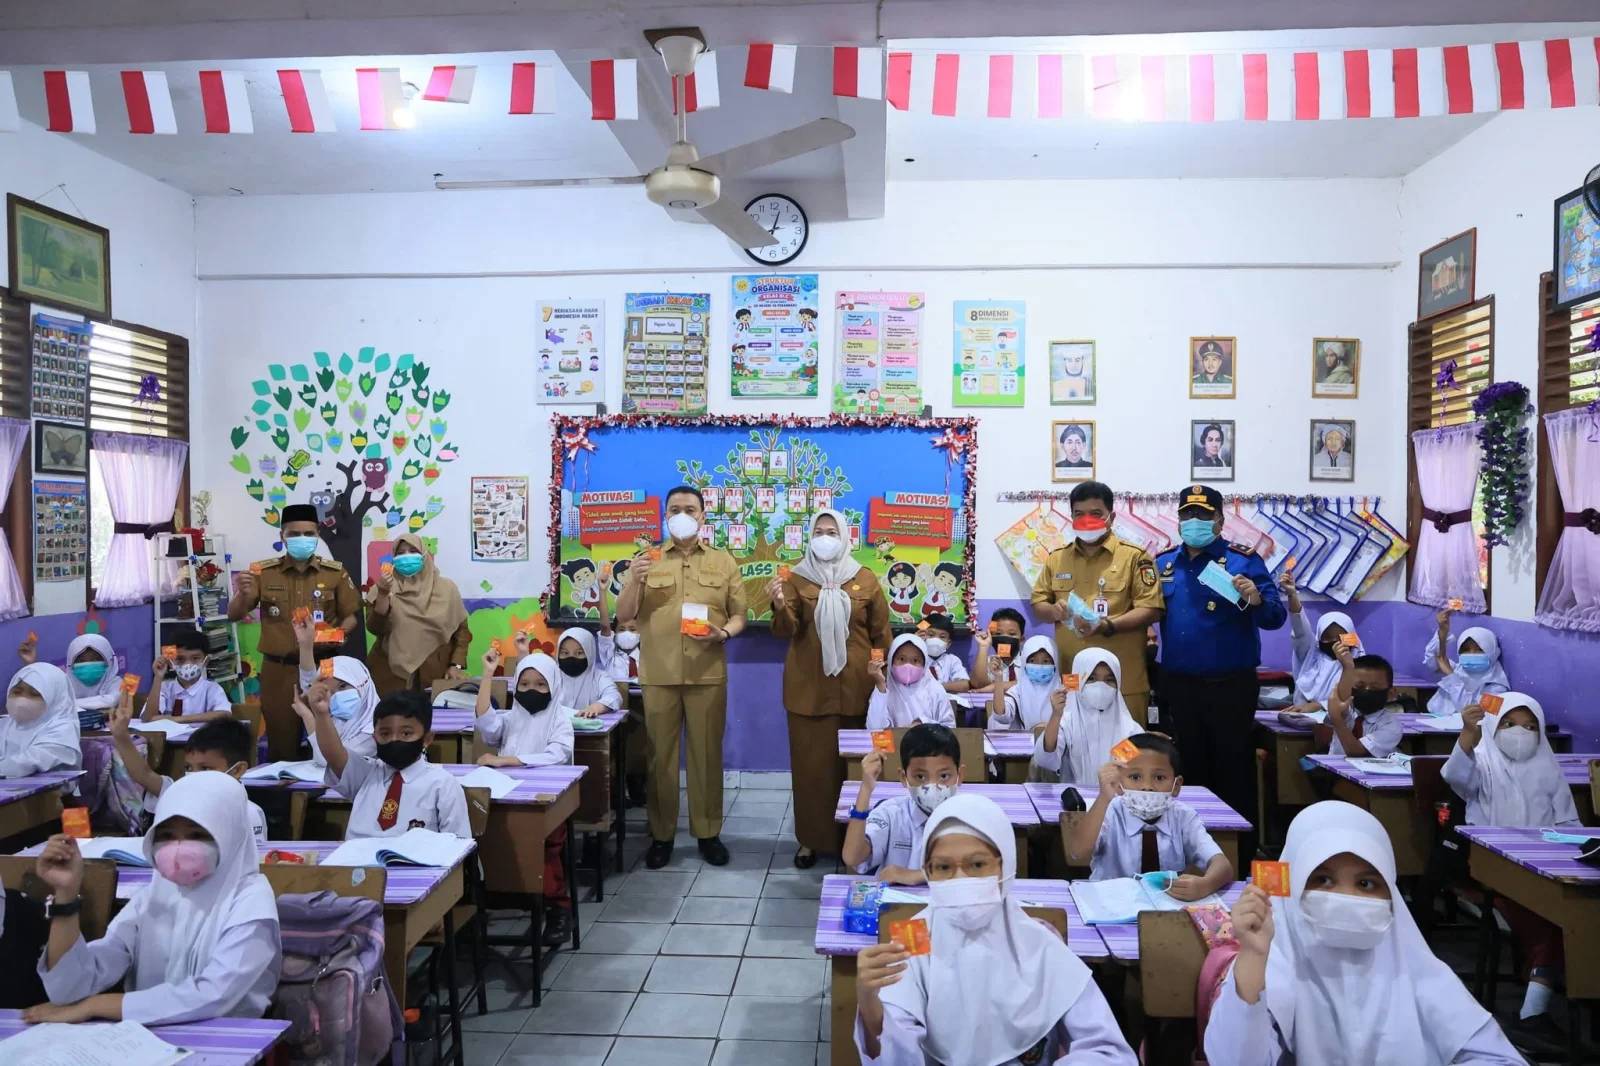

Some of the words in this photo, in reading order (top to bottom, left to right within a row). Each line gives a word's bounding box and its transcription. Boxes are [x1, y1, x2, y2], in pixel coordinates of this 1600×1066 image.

[770, 202, 779, 210] 12
[791, 214, 798, 222] 2
[769, 250, 776, 258] 6
[781, 247, 788, 255] 5
[751, 285, 800, 293] ORGANISASI
[666, 296, 692, 306] KELAS
[542, 306, 553, 322] 7
[970, 311, 978, 321] 8
[687, 396, 706, 404] BACA
[582, 492, 633, 502] MOTIVASI
[896, 493, 949, 505] MOTIVASI
[740, 563, 772, 577] LASS
